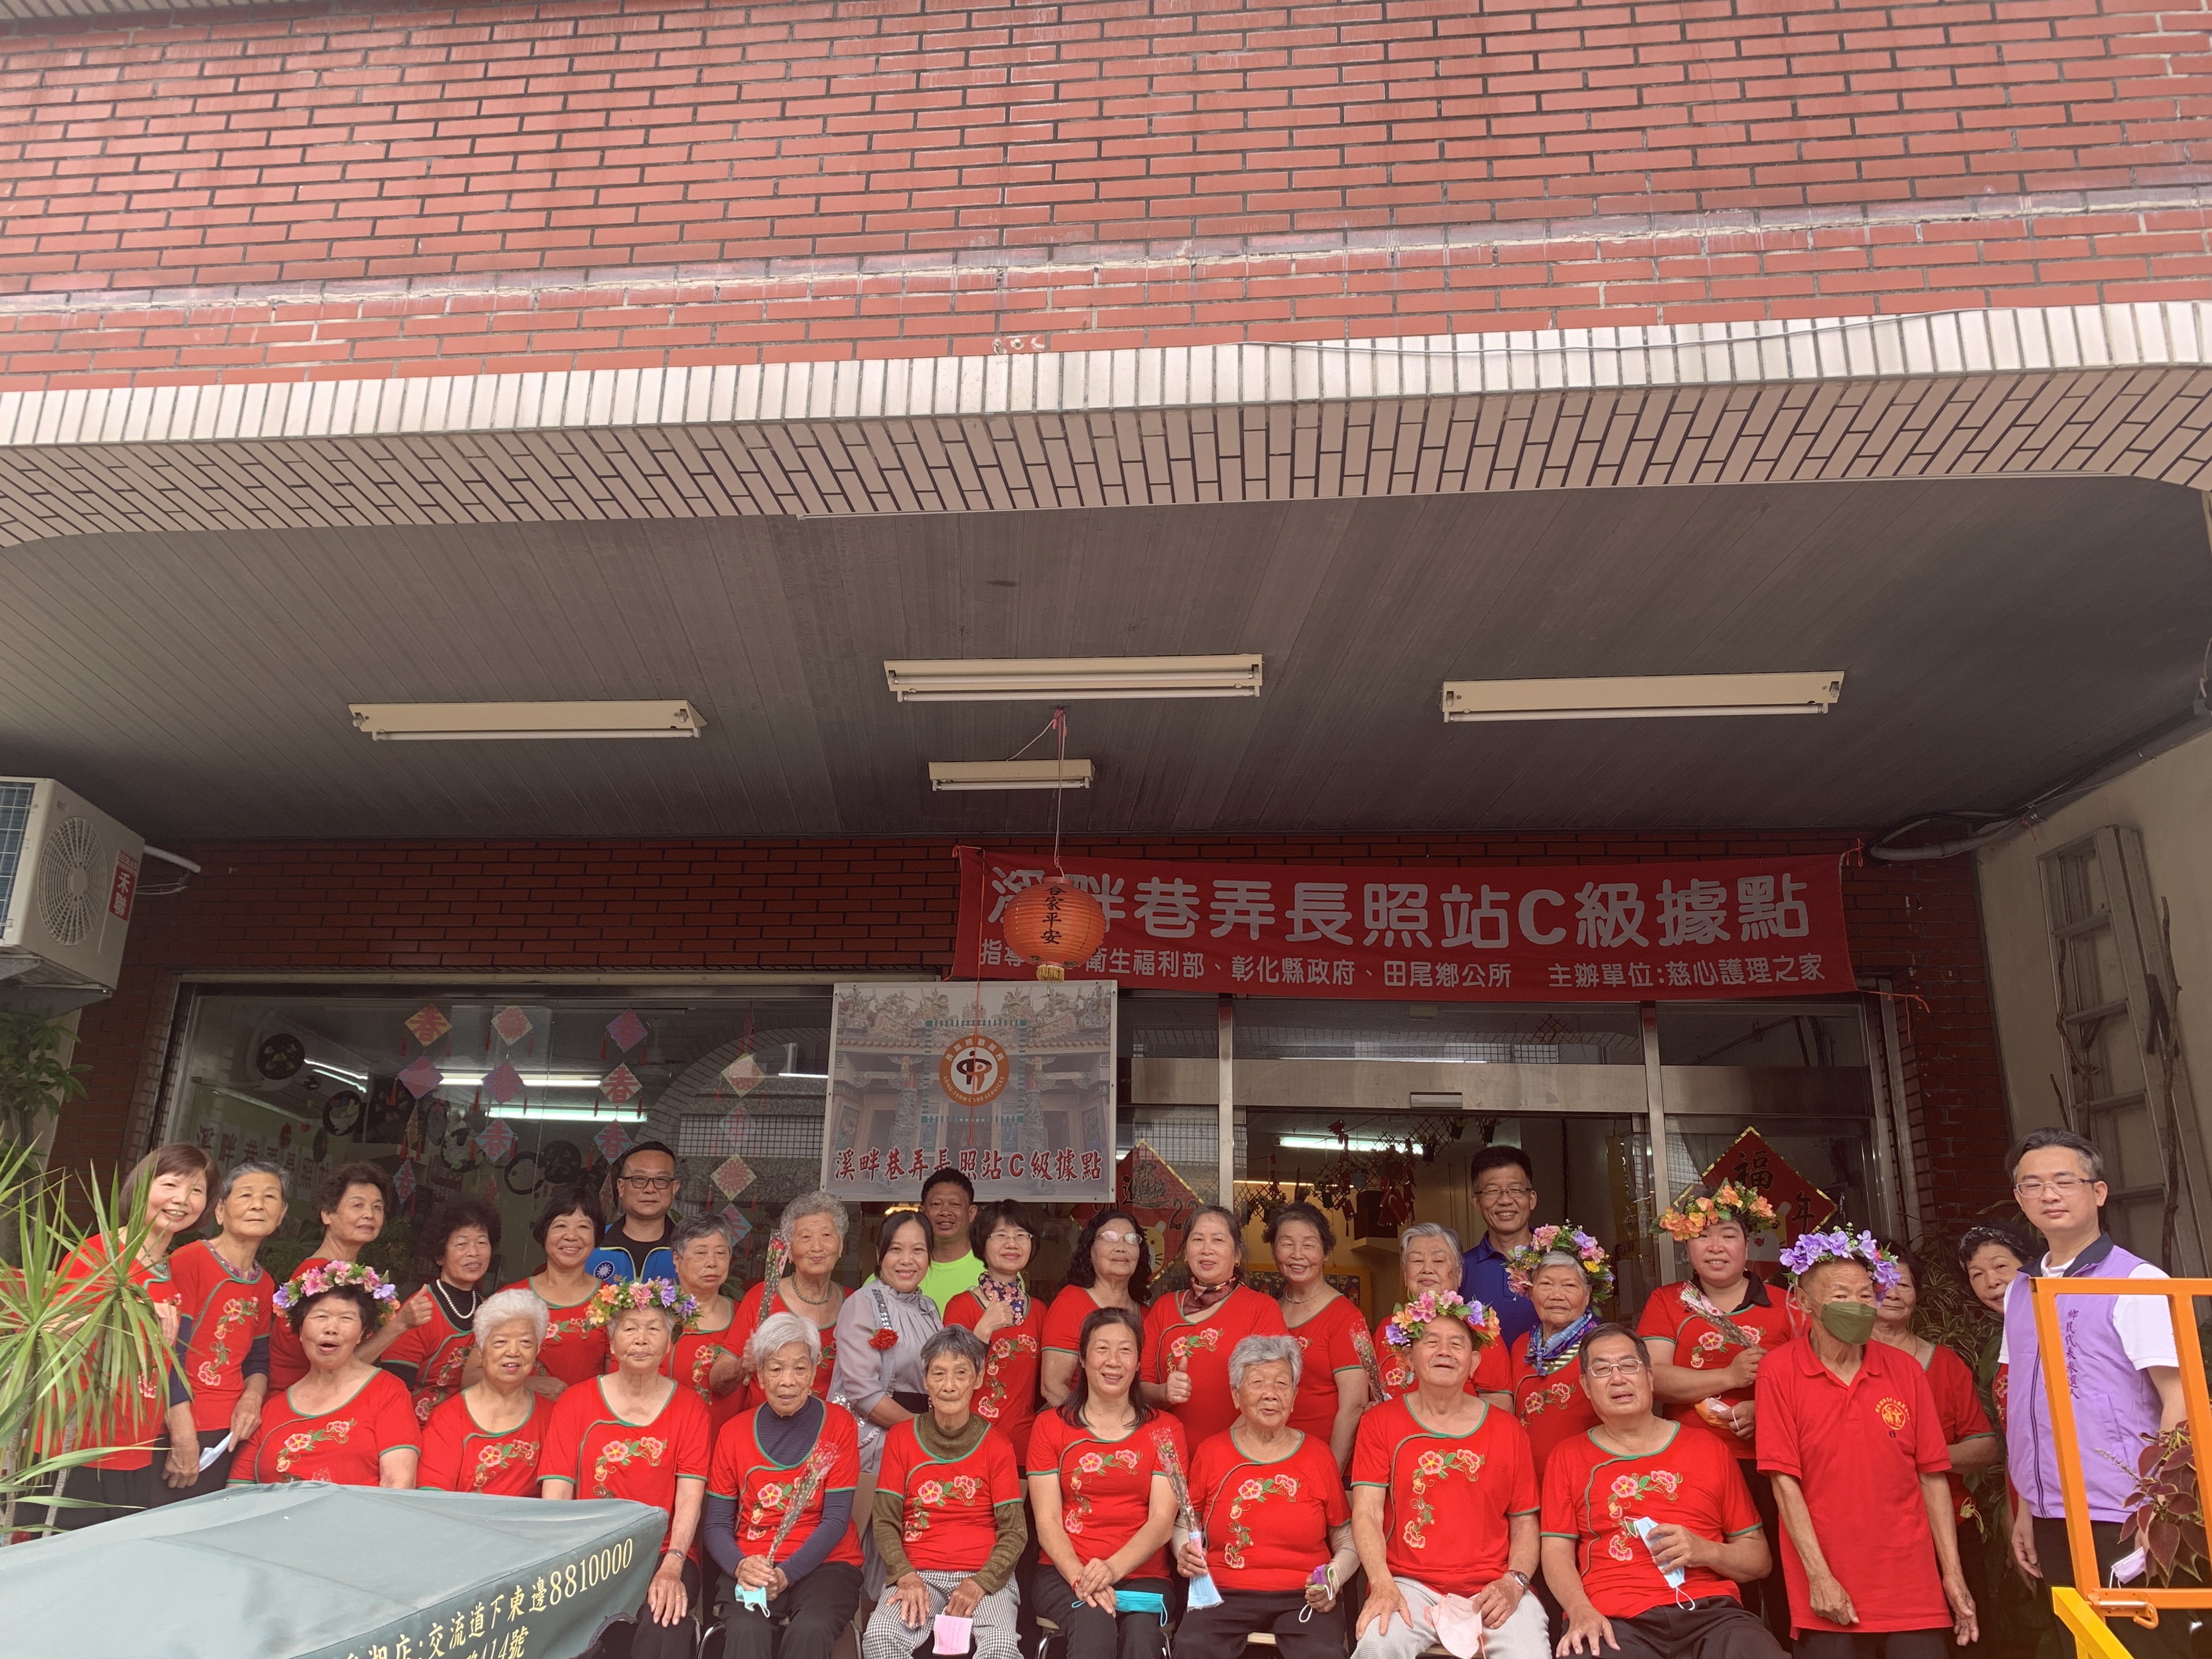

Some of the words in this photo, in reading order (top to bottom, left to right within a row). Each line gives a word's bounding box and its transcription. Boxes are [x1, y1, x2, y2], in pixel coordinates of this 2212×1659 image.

[1041, 885, 1066, 945] 合家平安
[409, 1005, 448, 1041] 春
[602, 1066, 639, 1103] 春
[944, 1076, 967, 1102] LONG-TERM
[984, 1076, 1005, 1099] SERVICES
[479, 1119, 514, 1157] 春
[598, 1120, 630, 1159] 春
[1791, 1191, 1816, 1234] 年
